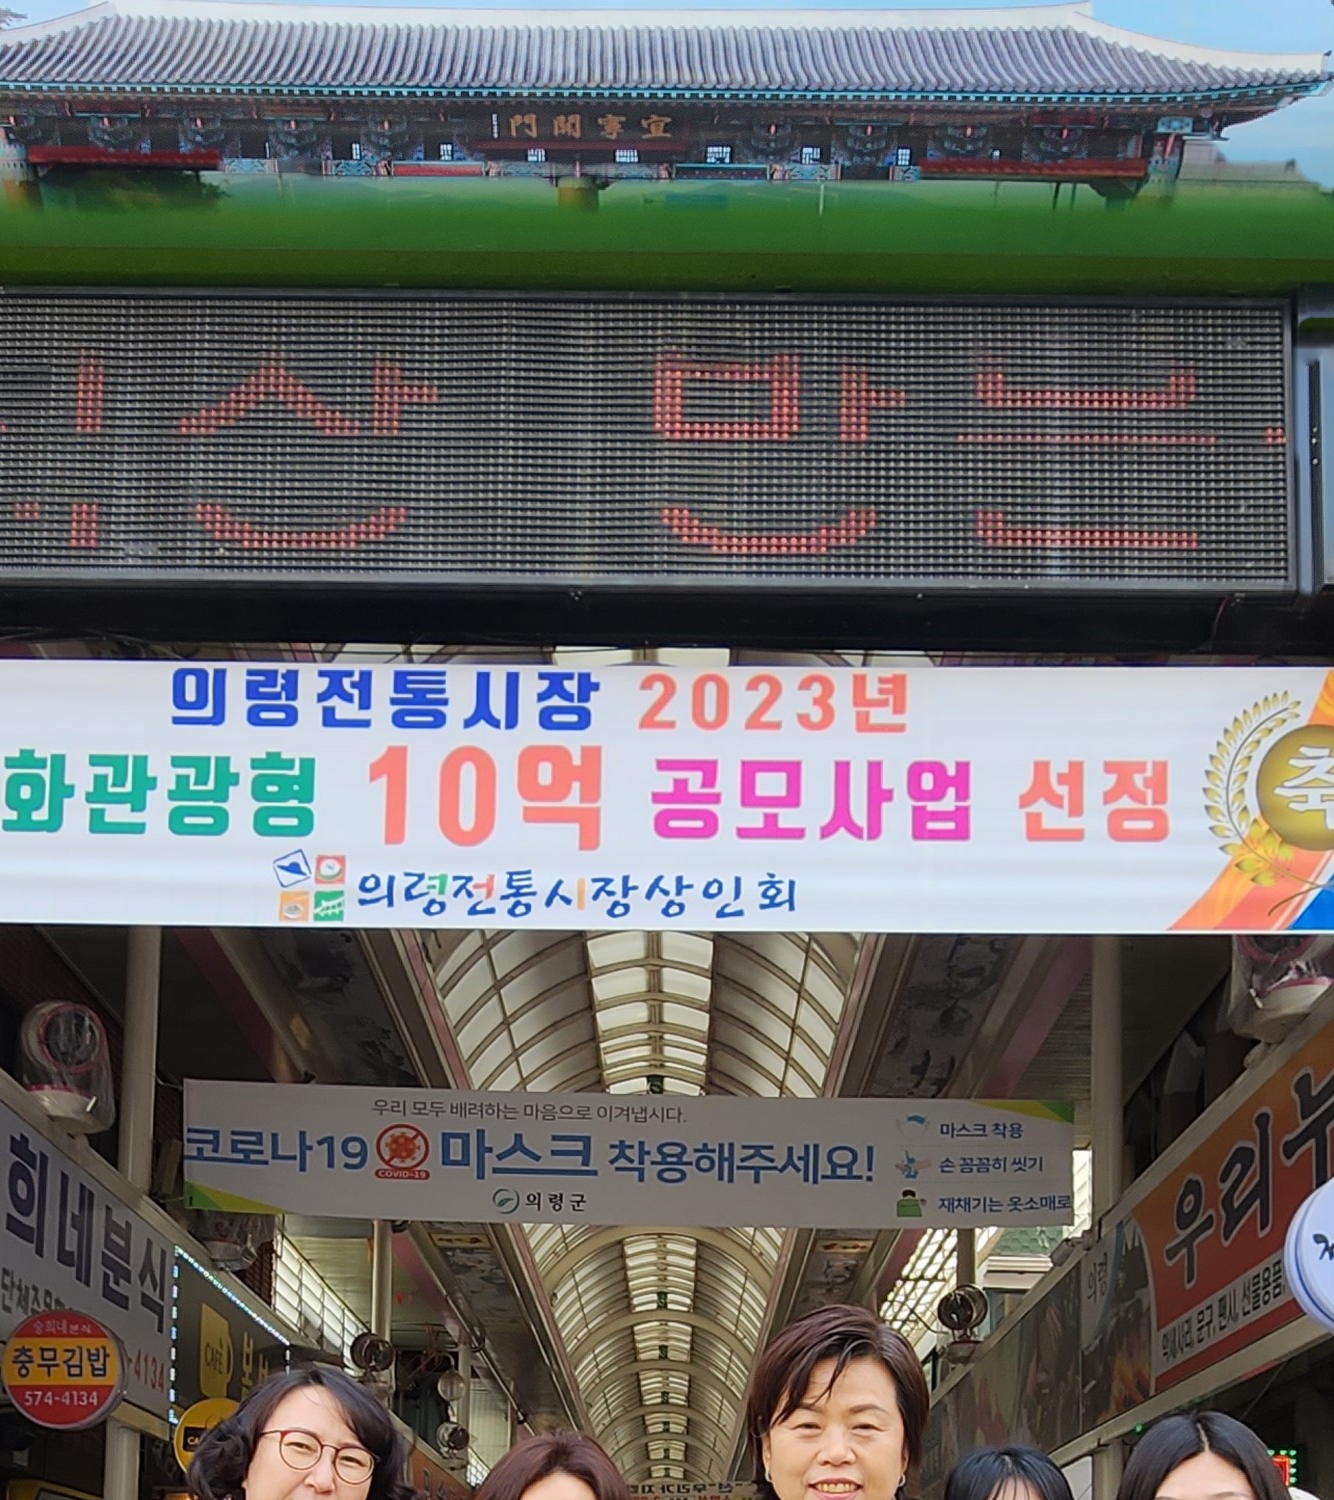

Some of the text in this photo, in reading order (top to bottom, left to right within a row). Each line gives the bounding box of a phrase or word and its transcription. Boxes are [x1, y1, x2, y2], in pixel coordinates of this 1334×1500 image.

[170, 666, 908, 735] 의령전통시장 2023년
[368, 743, 603, 851] 10억
[651, 757, 973, 843] 공모사업
[1018, 757, 1171, 843] 선정
[357, 867, 797, 920] 의령전통시장상인회
[372, 1099, 687, 1124] 우리 모두 배려하는 마음으로 이겨냅시다.
[939, 1121, 1024, 1140] 마스크 착용
[183, 1126, 875, 1186] 코로나19 마스크 착용해주세요!
[939, 1156, 1044, 1174] 손 꼼꼼히 씻기
[524, 1192, 588, 1213] 의령군
[938, 1195, 1003, 1214] 재채기는
[12, 1345, 110, 1378] 충무김밥
[24, 1391, 98, 1406] 574-4134
